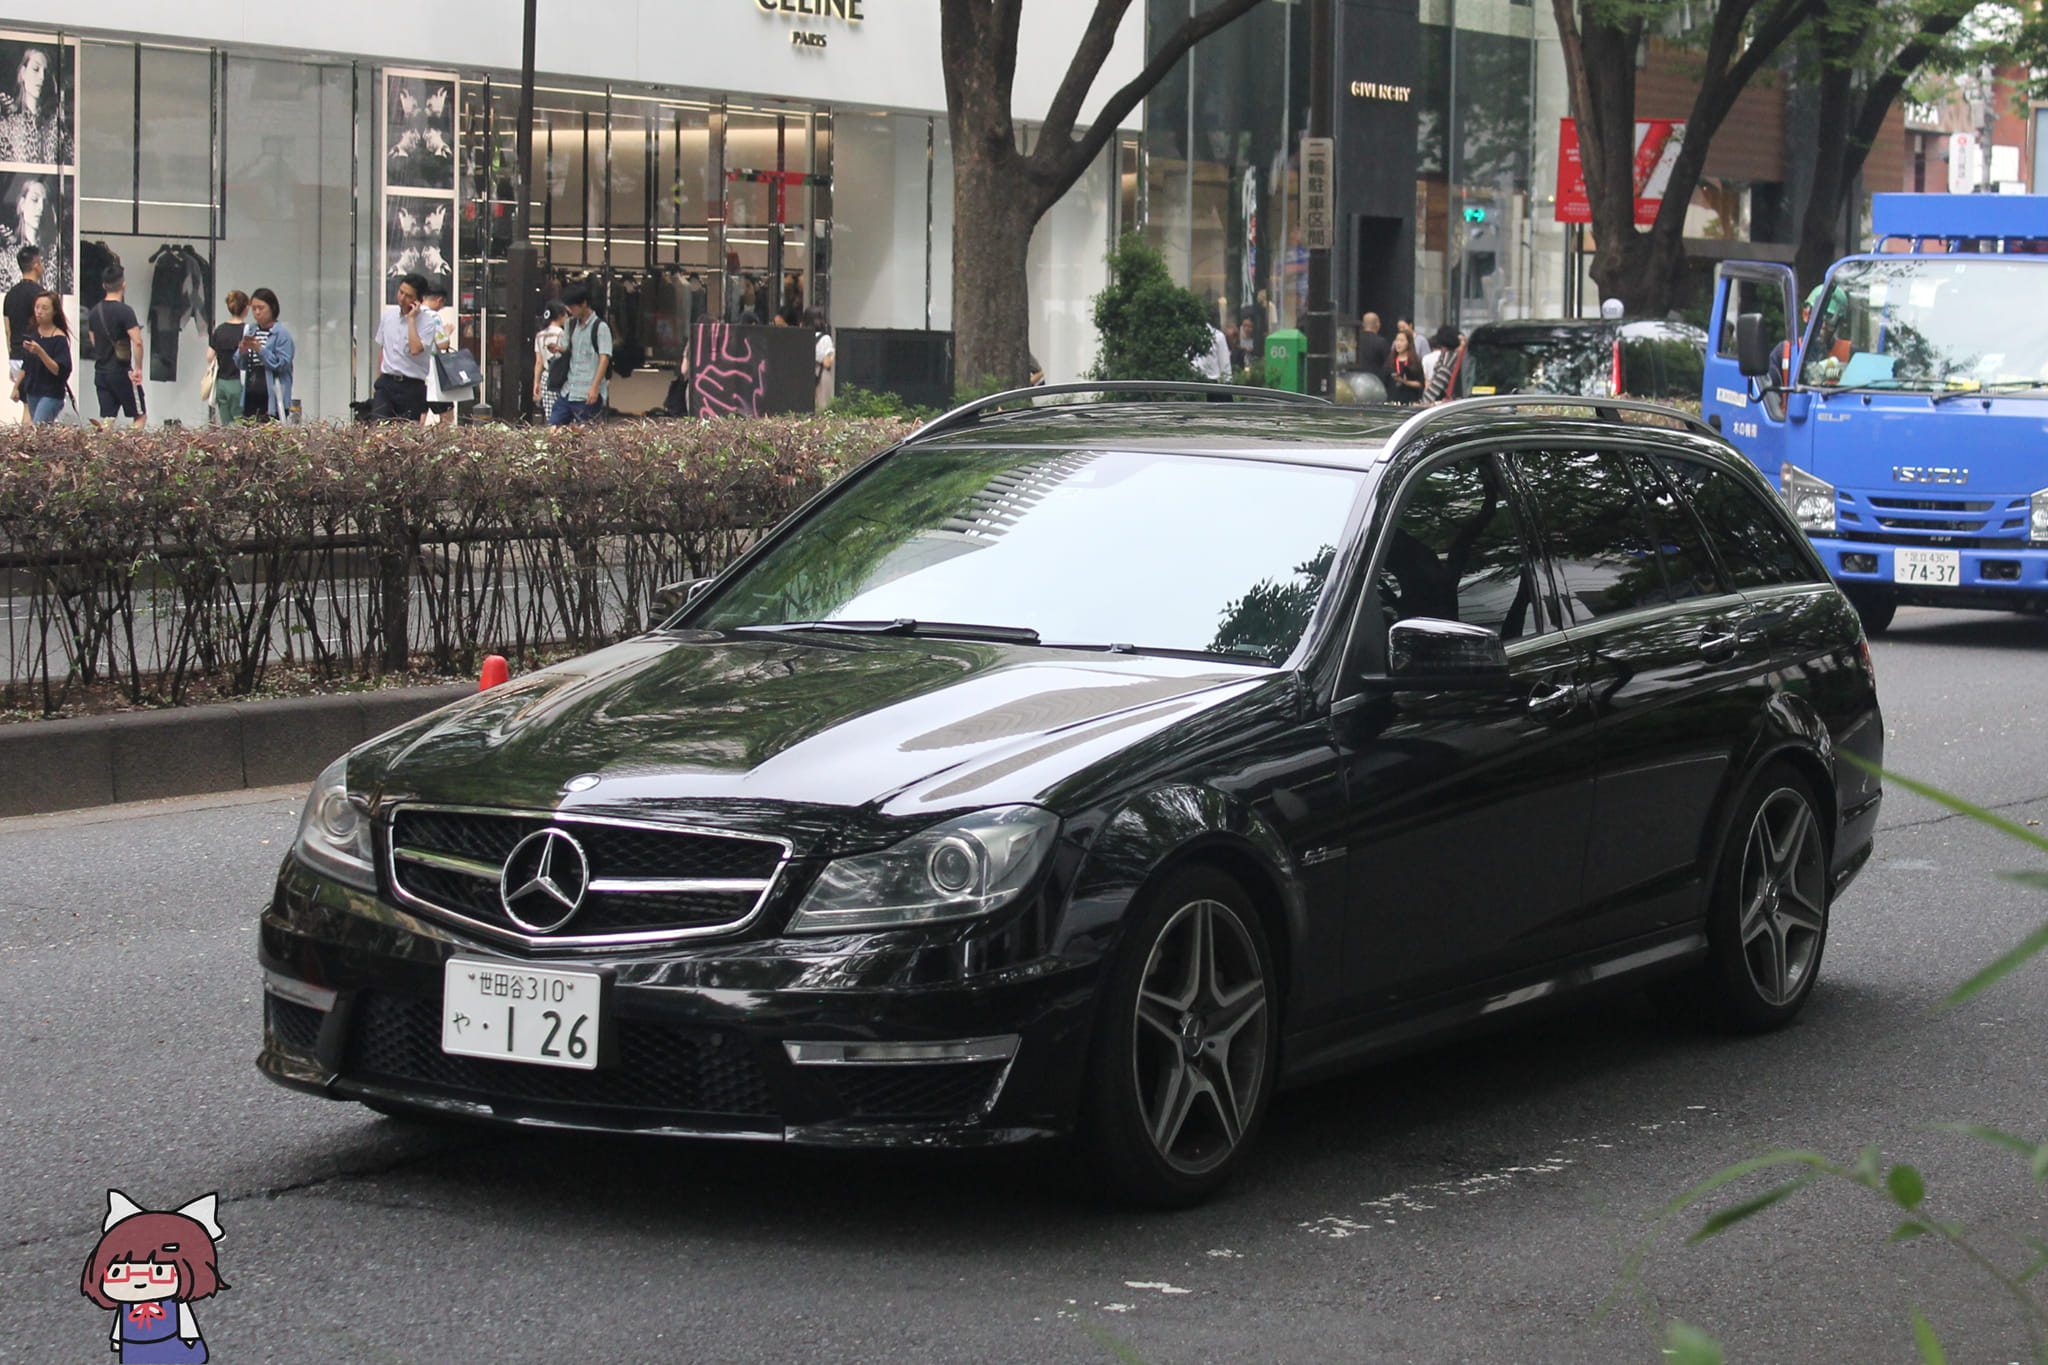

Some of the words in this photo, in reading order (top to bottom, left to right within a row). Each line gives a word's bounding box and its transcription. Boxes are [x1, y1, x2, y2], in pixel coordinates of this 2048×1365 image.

[758, 0, 864, 20] LNE
[792, 31, 827, 47] PARIS
[1892, 466, 1969, 485] ISUZU
[1909, 563, 1956, 583] 74-37
